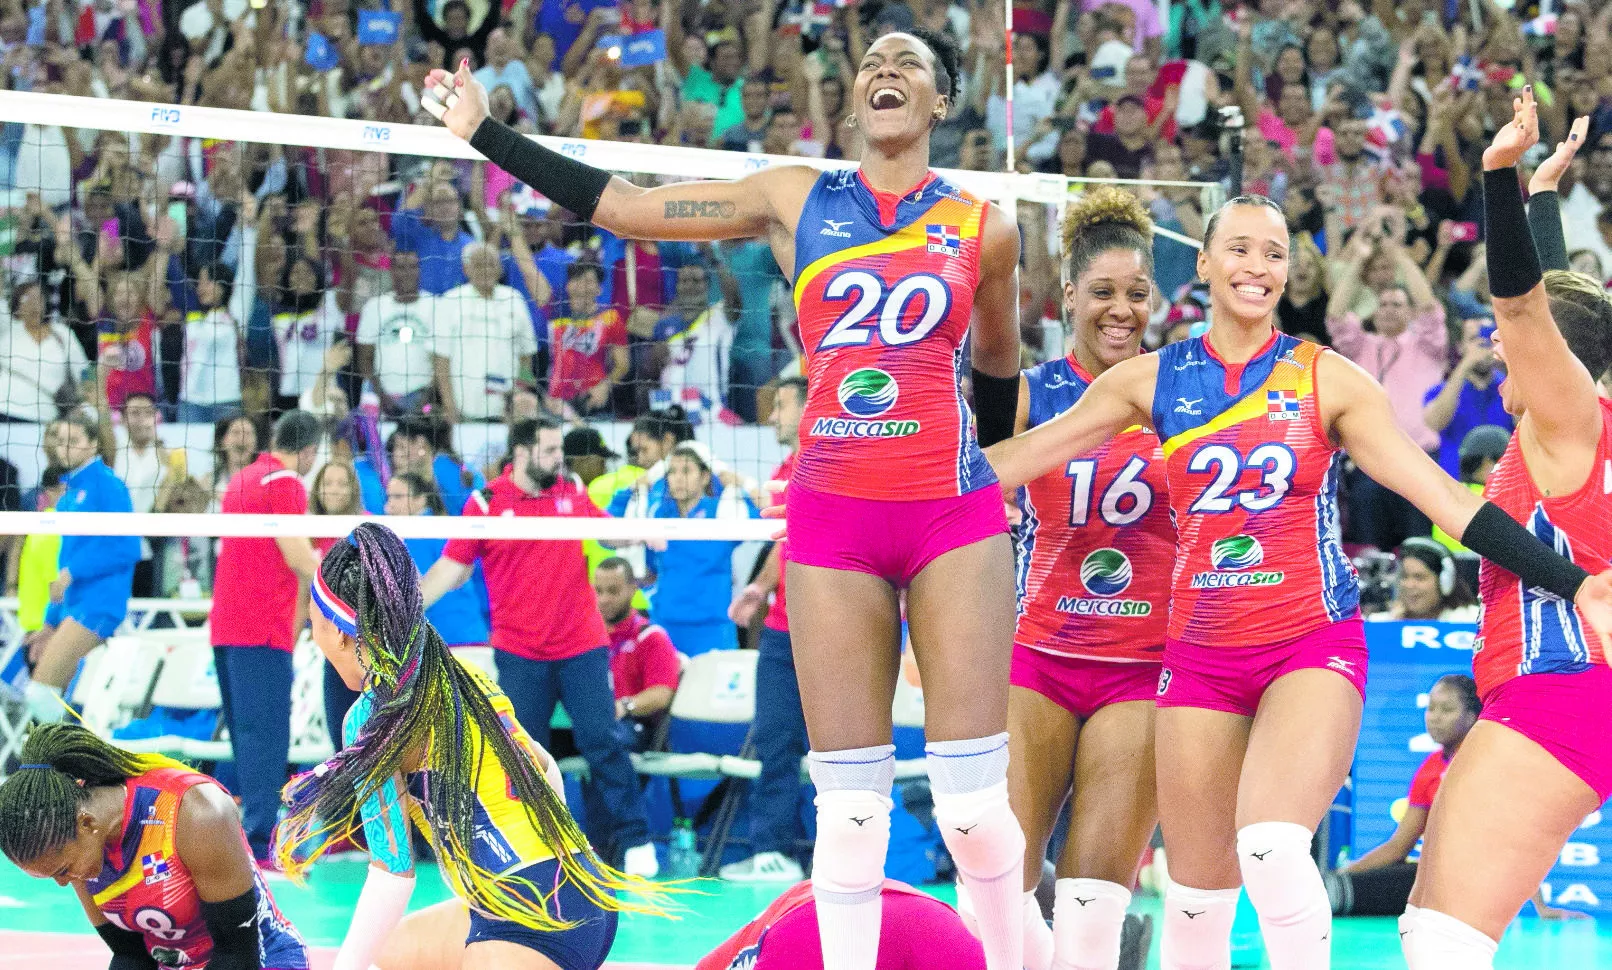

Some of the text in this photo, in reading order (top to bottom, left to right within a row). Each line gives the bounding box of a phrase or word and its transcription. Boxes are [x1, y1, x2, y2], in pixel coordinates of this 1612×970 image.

[152, 107, 180, 122] FIVB
[816, 269, 952, 352] 20
[1065, 454, 1155, 527] 16
[1187, 442, 1297, 514] 23
